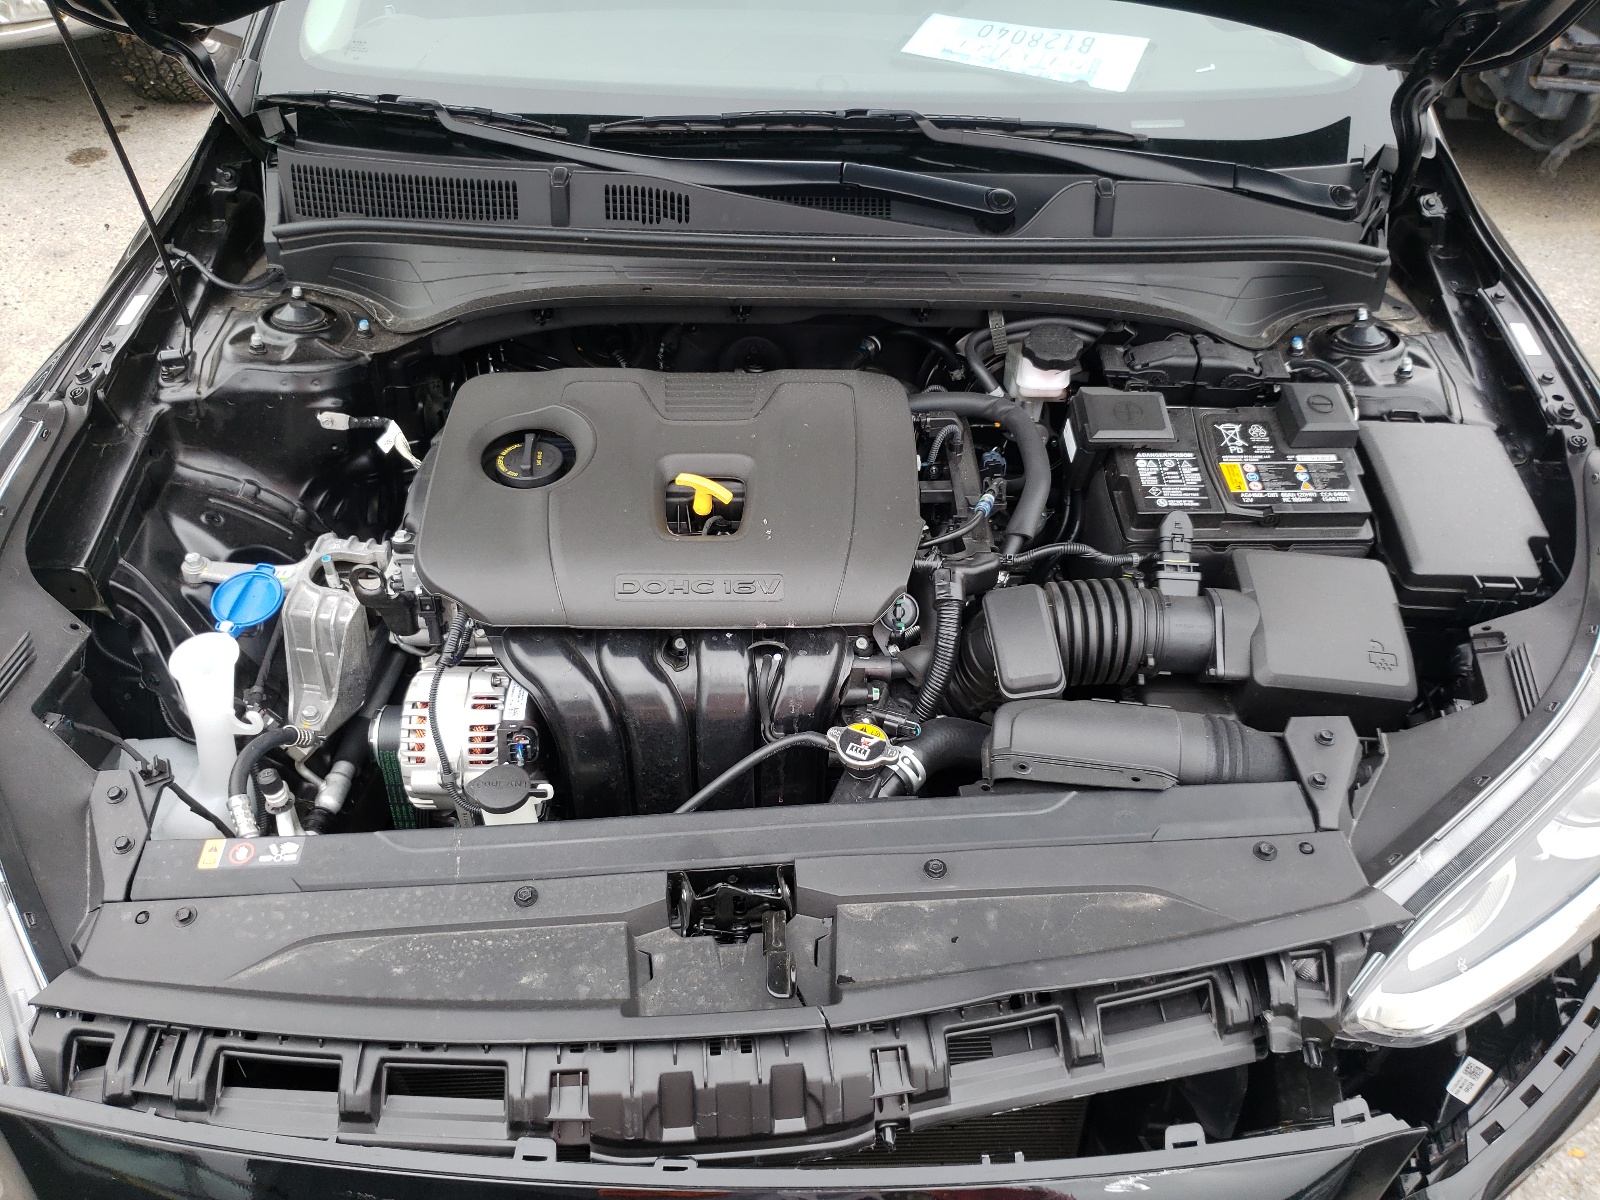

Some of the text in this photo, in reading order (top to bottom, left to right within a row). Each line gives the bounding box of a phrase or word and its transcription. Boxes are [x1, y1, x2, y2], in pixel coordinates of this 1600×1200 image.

[977, 24, 1096, 54] B128040
[617, 579, 782, 595] DOHC 16V
[476, 779, 528, 789] COOLANT
